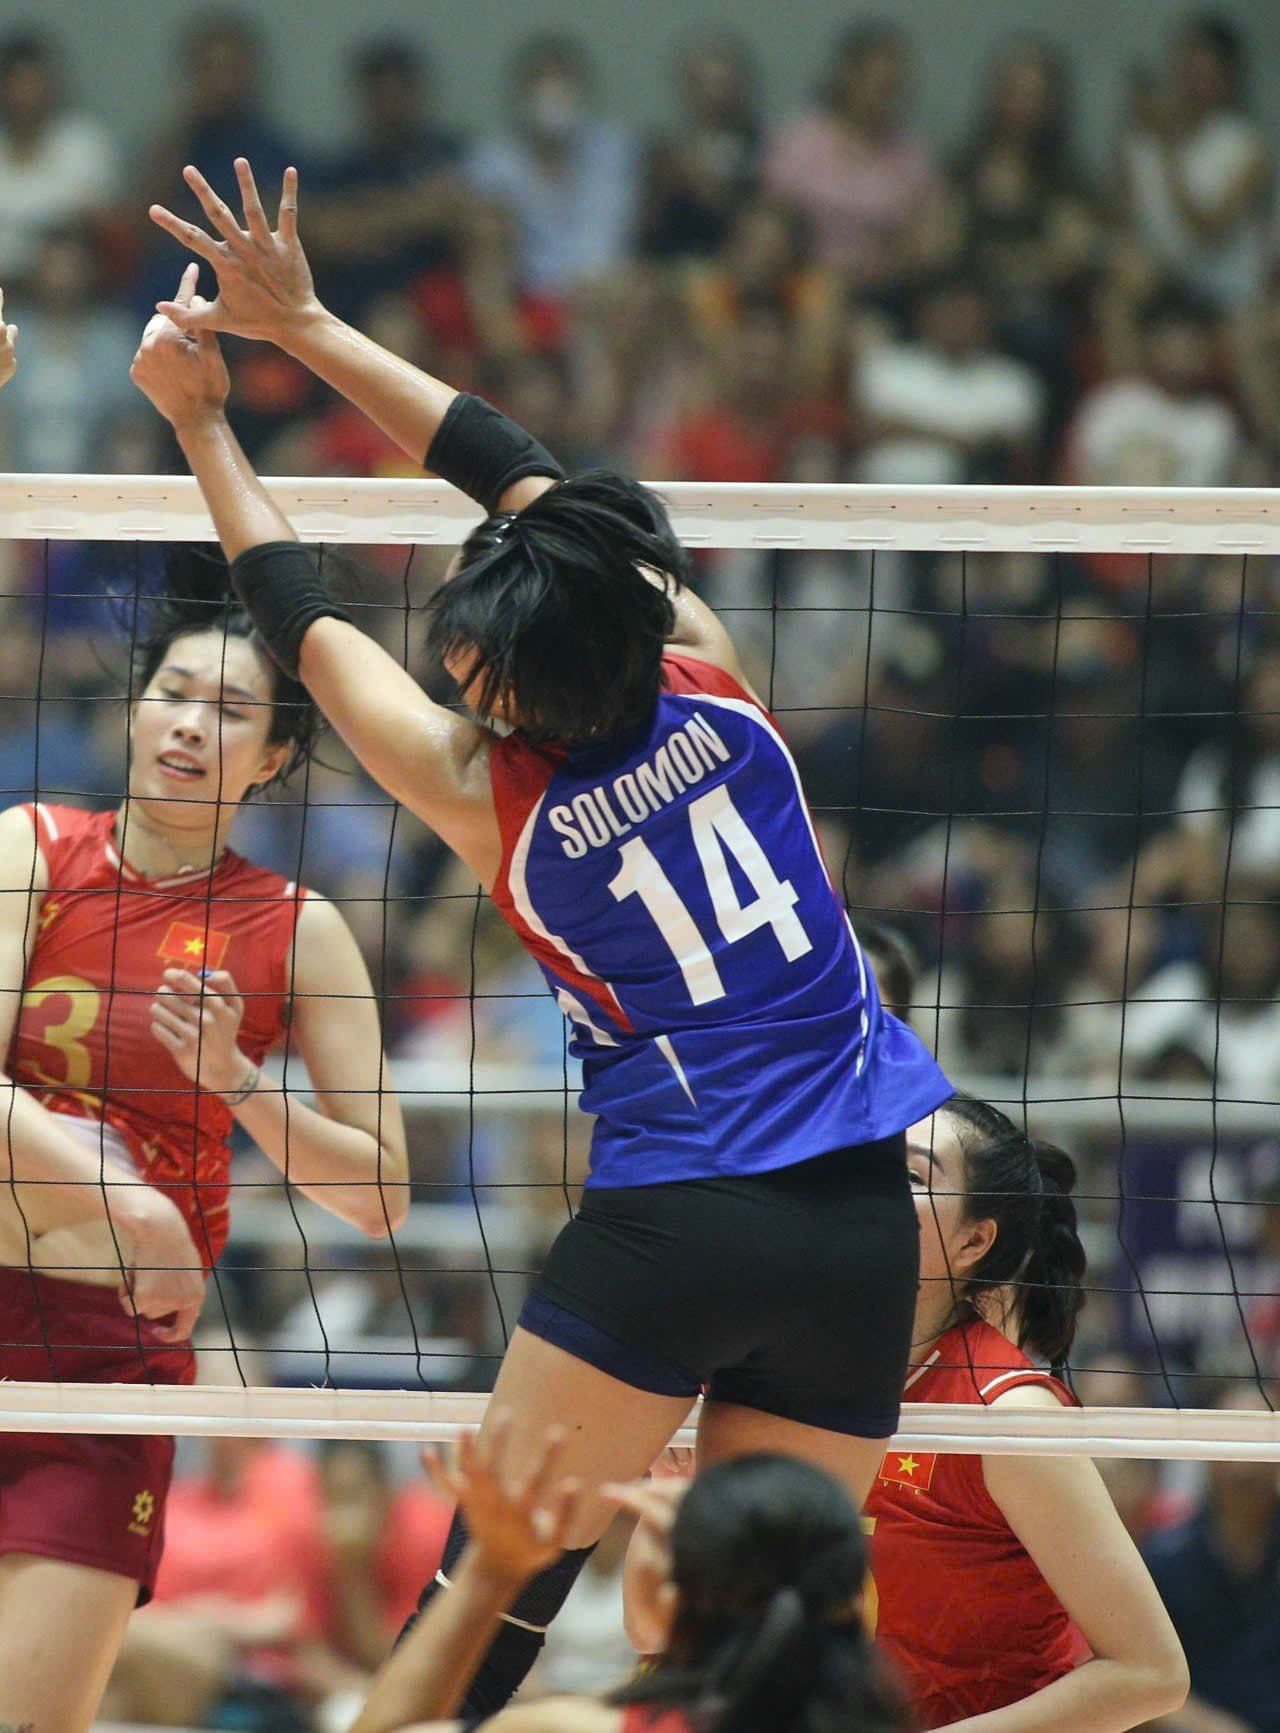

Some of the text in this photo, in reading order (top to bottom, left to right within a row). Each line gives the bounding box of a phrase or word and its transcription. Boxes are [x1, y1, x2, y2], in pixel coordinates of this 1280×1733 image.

[548, 711, 731, 859] SOLOMON
[607, 784, 813, 1006] 14
[21, 975, 101, 1091] 3
